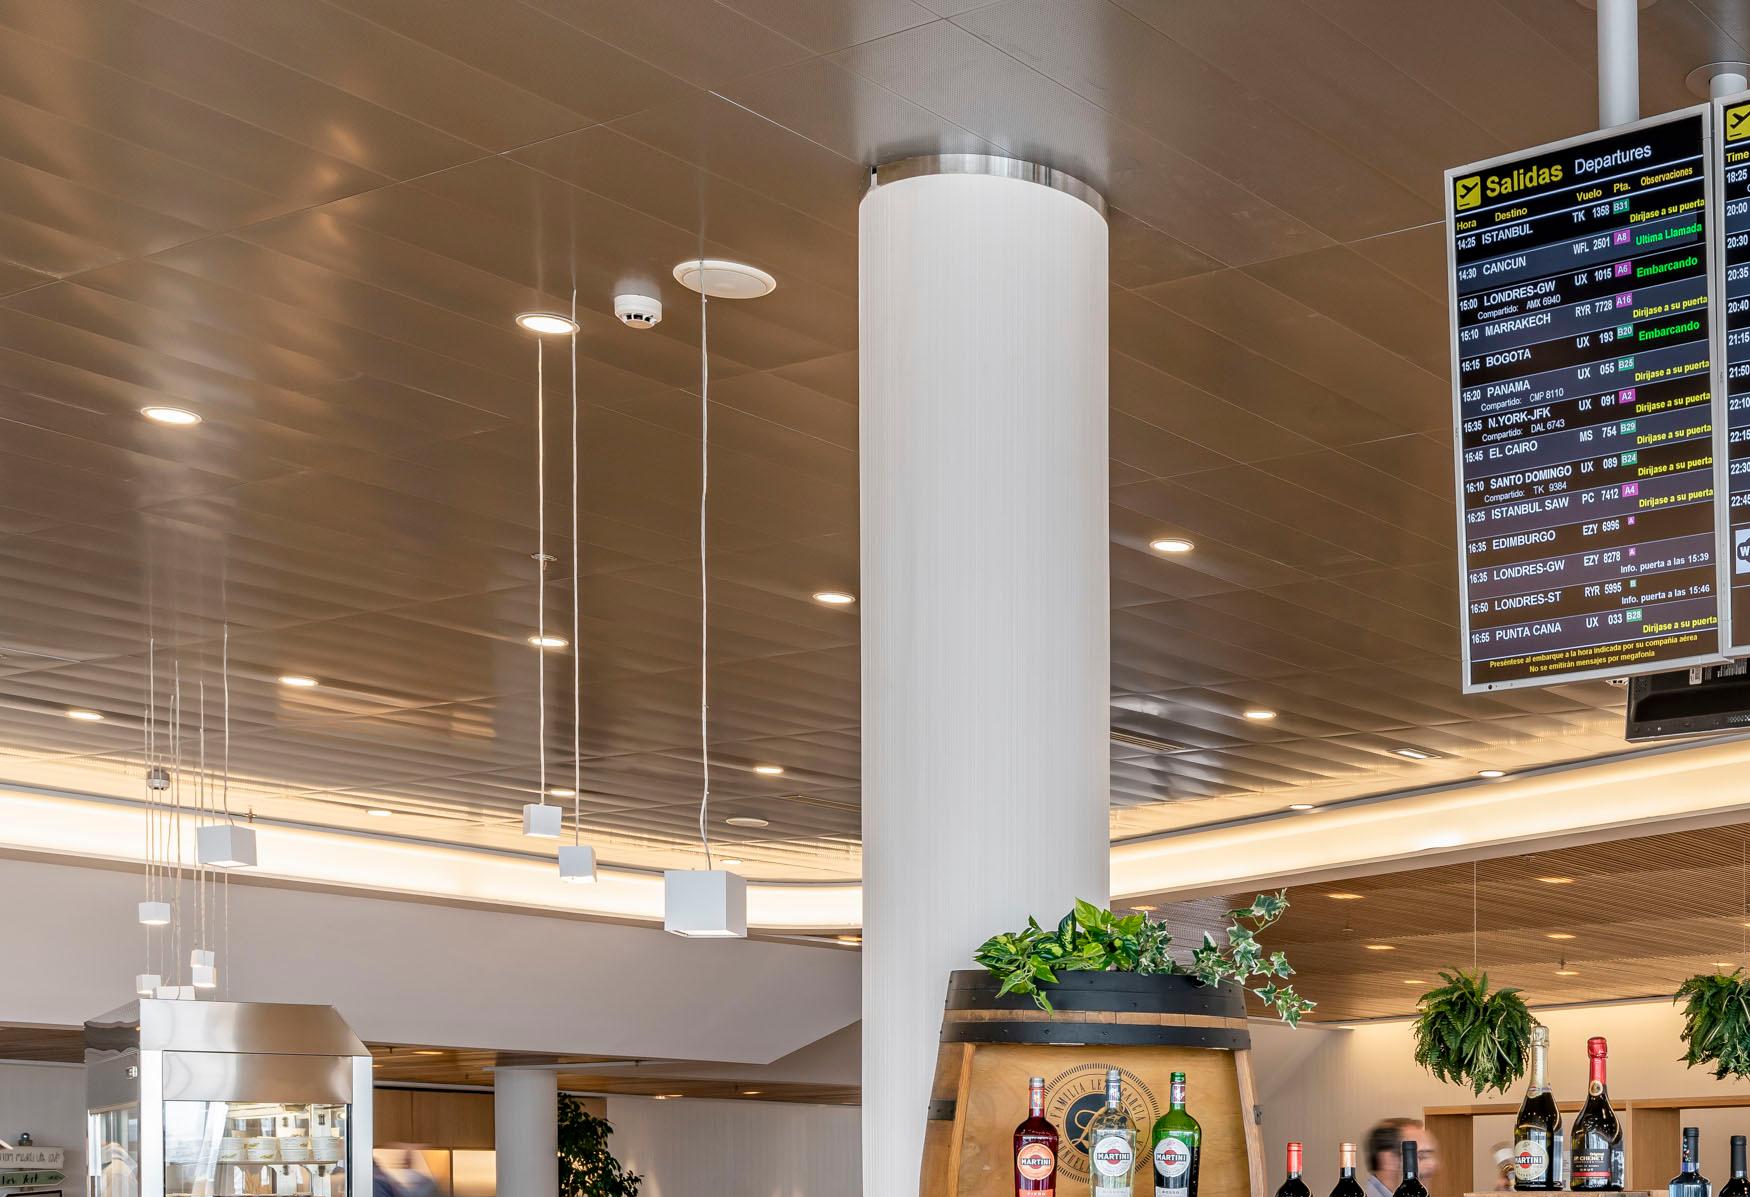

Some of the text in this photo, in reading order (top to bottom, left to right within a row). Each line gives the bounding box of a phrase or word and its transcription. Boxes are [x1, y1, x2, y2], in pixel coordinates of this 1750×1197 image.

[1726, 150, 1749, 163] Time
[1486, 145, 1651, 197] Salidas Departures
[1726, 169, 1747, 183] 18:25
[1456, 167, 1692, 231] Hora Destino Vuelo Pta. Observaciones
[1669, 205, 1678, 214] su
[1680, 198, 1704, 213] puerta
[1727, 202, 1748, 216] 20:00
[1457, 205, 1609, 250] 14:25 ISTANBUL TK 1358
[1459, 268, 1477, 280] 14:30
[1483, 256, 1526, 275] CANCUN
[1573, 242, 1589, 254] WFL
[1593, 238, 1610, 250] 2501
[1617, 232, 1627, 242] A8
[1665, 223, 1702, 240] Llamada
[1727, 235, 1748, 248] 20:30
[1460, 257, 1698, 311] 15:00 LONDRES-GW UX 1015 Embarcando
[1728, 267, 1748, 281] 20:35
[1478, 295, 1560, 320] Compartido: AMX 6940
[1728, 300, 1749, 313] 20:40
[1461, 300, 1612, 341] 15:10 MARRAKECH RYR 7728
[1462, 321, 1700, 372] 15:15 BOGOTA UX 193 Embarcando
[1729, 332, 1750, 346] 21:15
[1729, 364, 1750, 378] 21:50
[1463, 380, 1530, 402] 15:20 PANAMA
[1730, 396, 1750, 410] 22:10
[1464, 407, 1550, 432] 15:35 N.YORK-JFK
[1730, 429, 1750, 443] 22:15
[1465, 441, 1537, 463] 15:45 EL CAIRO
[1466, 465, 1572, 493] 16:10 SANTO DOMINGO
[1467, 498, 1569, 523] 16:25 ISTANBUL SAW
[1468, 530, 1555, 554] 16:35 EDIMBURGO
[1470, 560, 1564, 584] 16:35 LONDRES-GW
[1471, 592, 1561, 614] 16:50 LONDRES-ST
[1472, 623, 1561, 644] 16:55 PUNTA CANA
[1021, 1157, 1051, 1166] MARTINI
[1097, 1152, 1131, 1160] MARTINI
[1156, 1152, 1187, 1161] MARTINI
